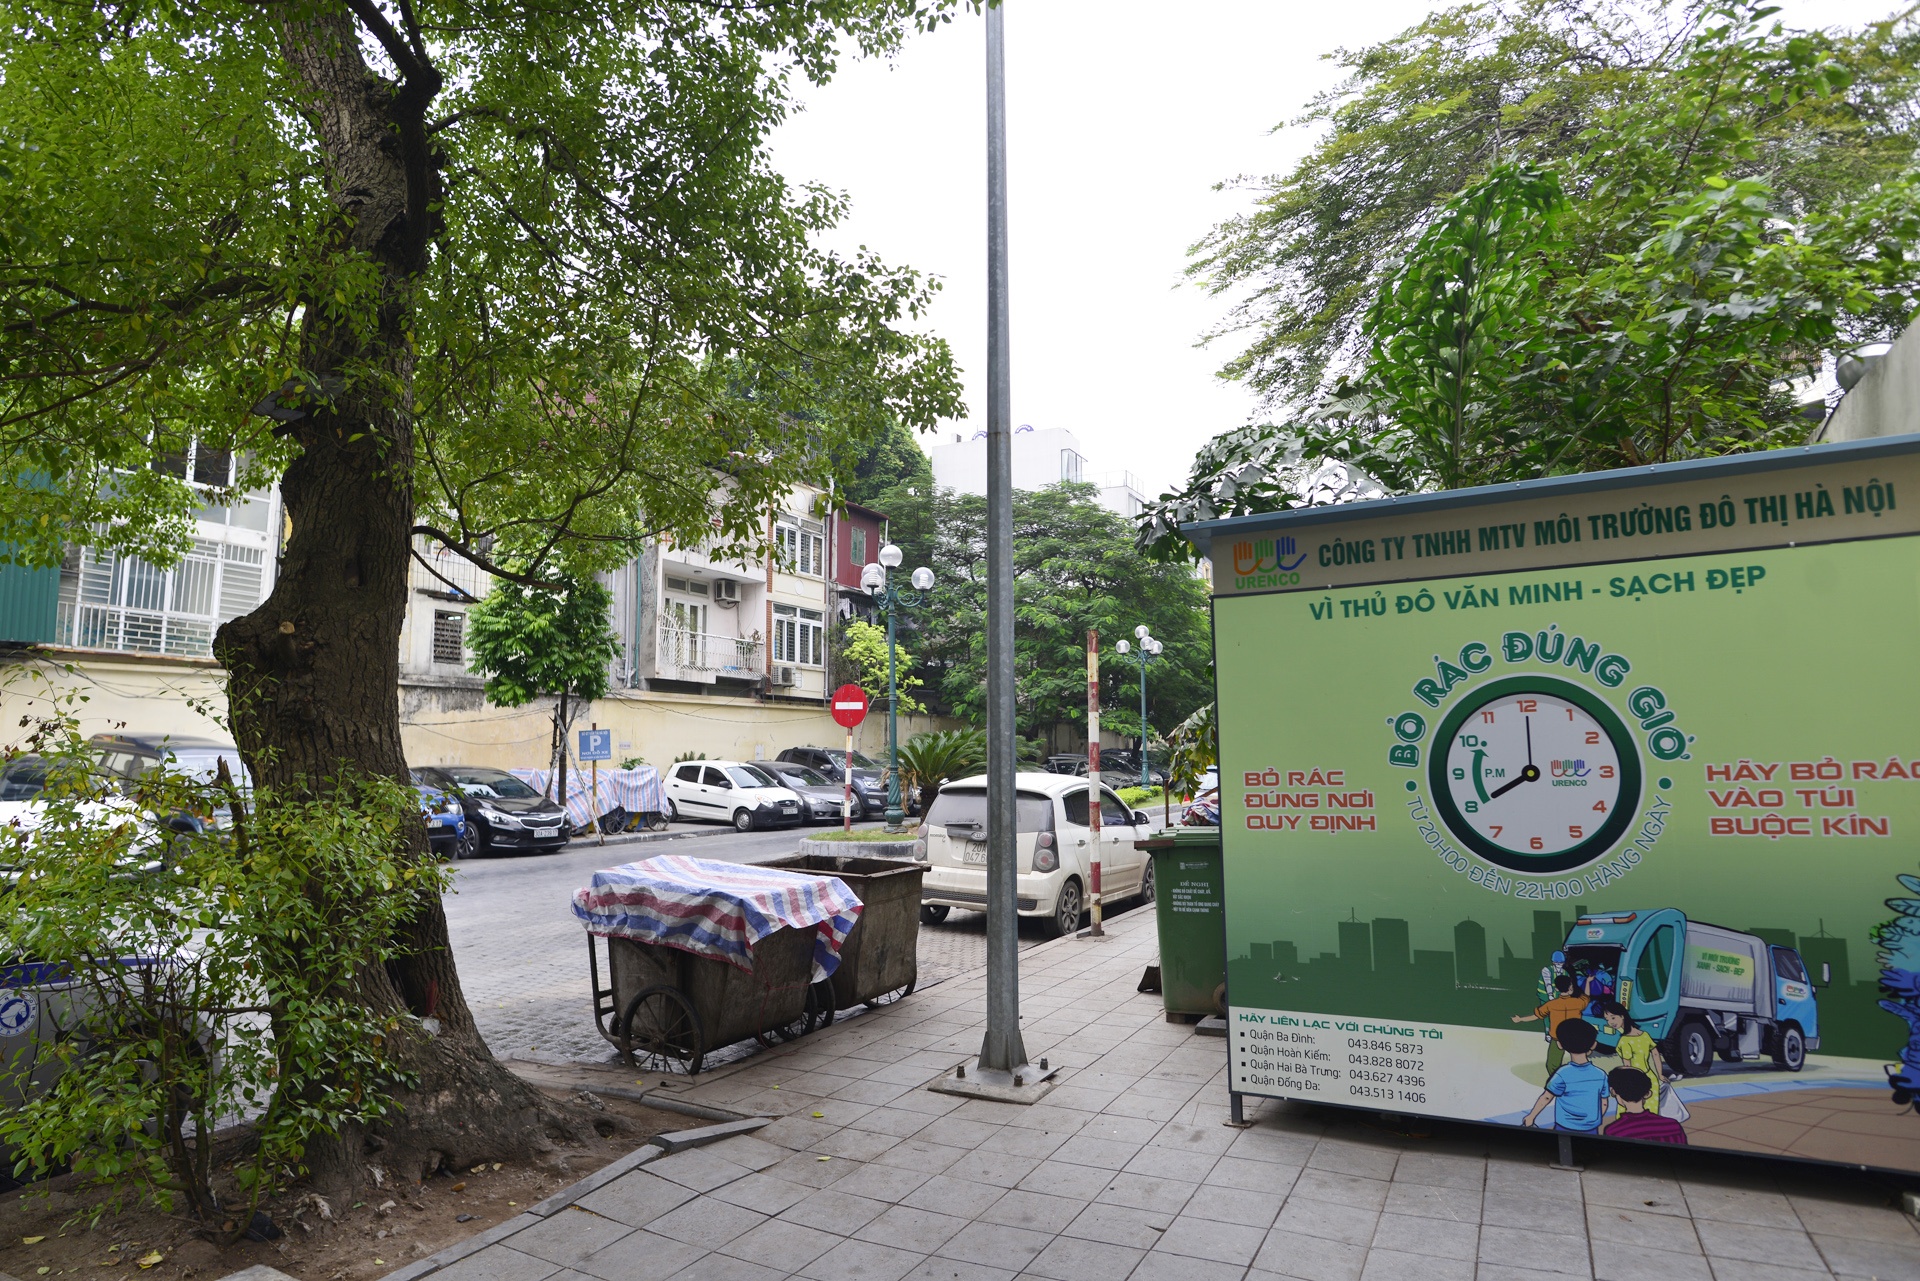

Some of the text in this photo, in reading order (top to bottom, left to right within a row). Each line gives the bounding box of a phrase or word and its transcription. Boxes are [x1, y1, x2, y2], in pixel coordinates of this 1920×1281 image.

[1319, 478, 1896, 567] CÔNG TY TNHH MTV MÔI TRƯỜNG ĐÔ THỊ HÀ NỘI
[1235, 572, 1300, 590] URENCO
[1309, 596, 1333, 621] VÌ
[1340, 590, 1387, 619] THỦ
[1395, 588, 1435, 614] ĐÔ
[1443, 584, 1499, 610] VĂN
[1509, 581, 1583, 605] MINH
[1609, 571, 1695, 602] SẠCH
[1706, 565, 1766, 594] ĐẸP
[1386, 624, 1695, 768] BỎ RÁC ĐÚNG GIỜ
[1516, 700, 1537, 713] 12
[1566, 708, 1573, 721] 1
[1481, 711, 1495, 723] 11
[590, 735, 602, 752] P
[1459, 735, 1478, 747] 10
[1585, 731, 1599, 744] 2
[1244, 767, 1344, 787] BỎ RÁC
[1453, 768, 1465, 780] 9
[1485, 768, 1505, 778] P.M
[1599, 766, 1614, 778] 3
[1706, 760, 1780, 782] HÃY
[1790, 757, 1843, 780] BỎ
[1244, 790, 1374, 808] ĐÚNG NƠI
[1708, 785, 1855, 807] VÀO TÚI
[1465, 801, 1478, 813] 8
[1592, 800, 1607, 813] 4
[1246, 815, 1376, 834] QUY ĐỊNH
[1490, 825, 1503, 838] 7
[1569, 825, 1583, 838] 5
[1710, 813, 1889, 839] BUỘC KÍN
[972, 843, 986, 852] 20A
[1407, 795, 1671, 899] TỪ 20H00 ĐẾN 22H00 HÀNG NGÀY
[1530, 837, 1543, 849] 6
[965, 853, 987, 863] 047.6
[1239, 1013, 1443, 1040] HÃY LIÊN LẠC VỚI CHÚNG TÔI
[1250, 1029, 1424, 1055] Quận Ba Đình: 043.846 5873
[1250, 1045, 1424, 1071] Quận Hoàn Kiếm: 043.828 8072
[1250, 1059, 1426, 1087] Quận Hai Bà Trưng: 043.627 4396
[1250, 1074, 1426, 1104] Quận Đống Đa: 043.513 1406
